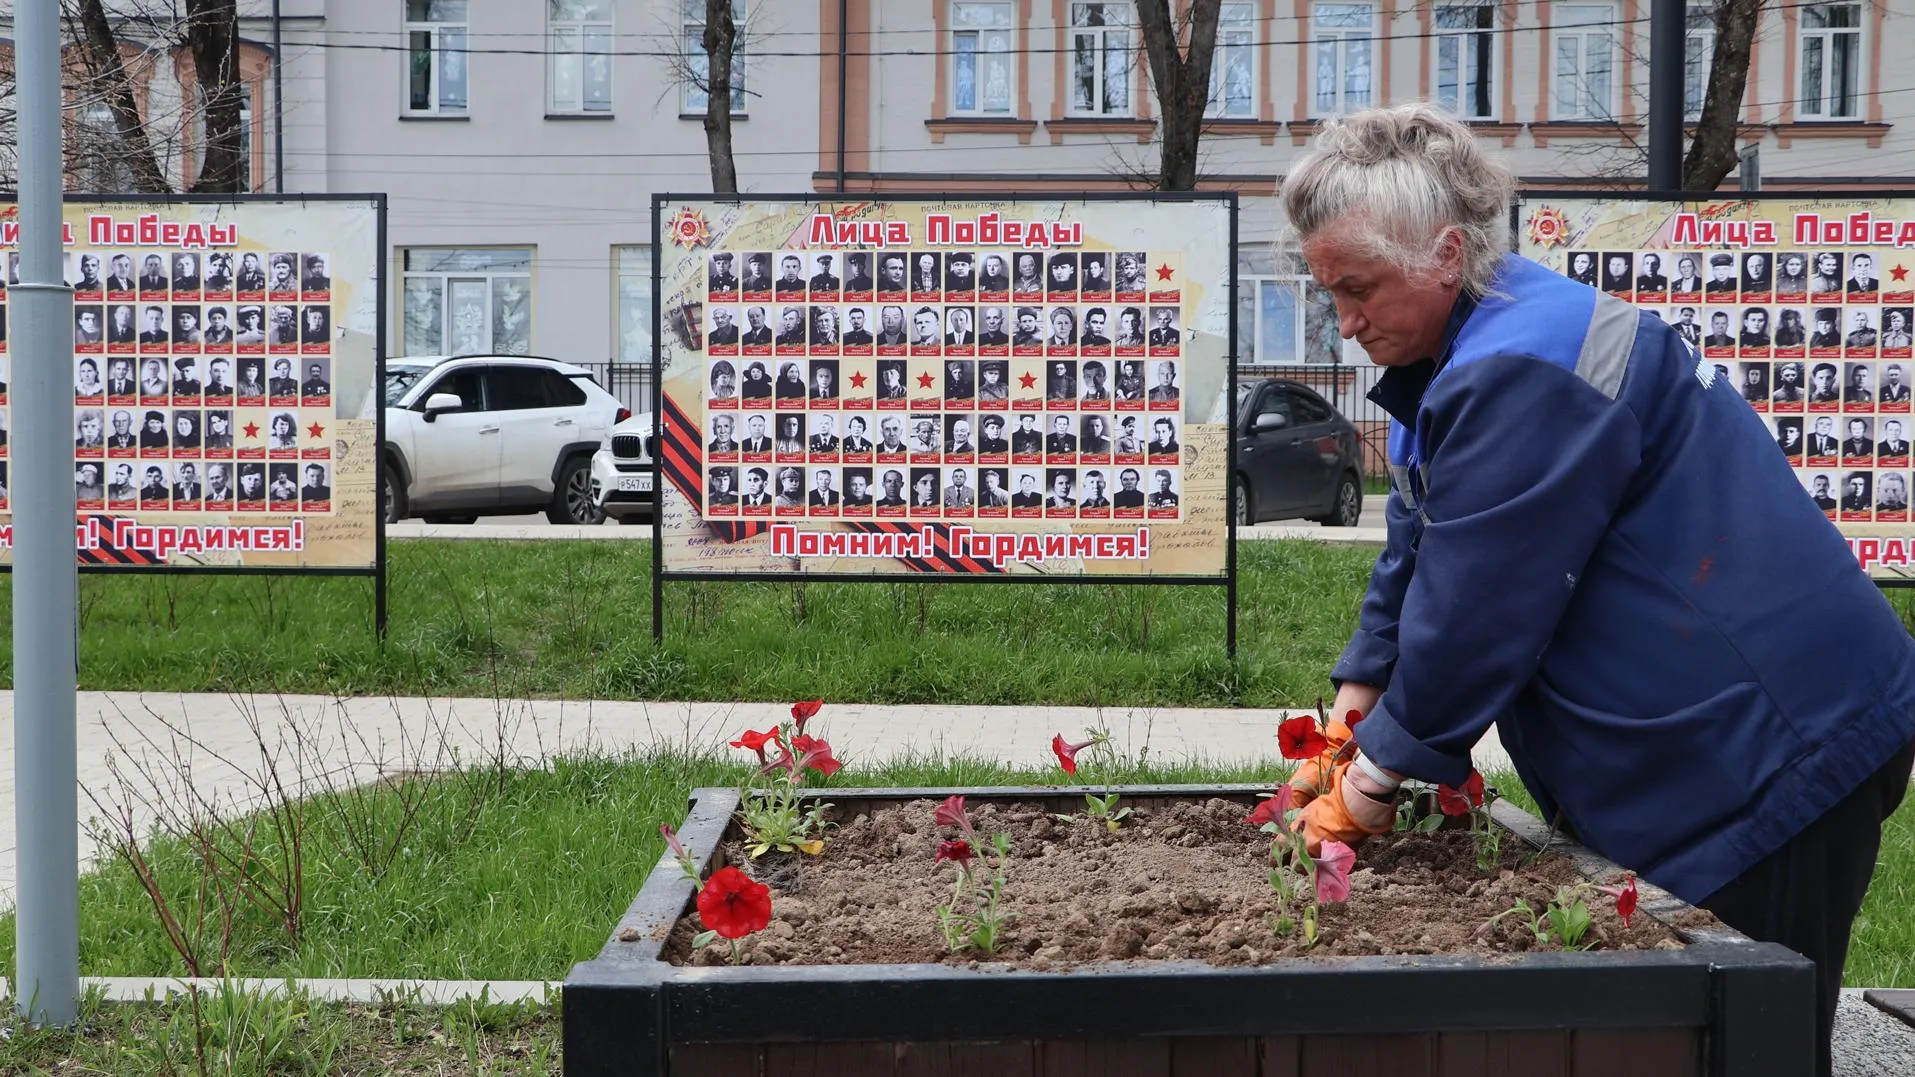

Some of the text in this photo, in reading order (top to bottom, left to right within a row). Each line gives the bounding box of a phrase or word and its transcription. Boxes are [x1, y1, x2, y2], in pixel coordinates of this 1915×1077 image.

[90, 214, 236, 247] Победы
[811, 215, 910, 248] Лица
[928, 212, 1081, 247] Победы
[1673, 215, 1775, 247] Лица
[115, 519, 303, 558] Гордимся!
[772, 526, 932, 556] Помним!
[951, 527, 1148, 566] Гордимся!
